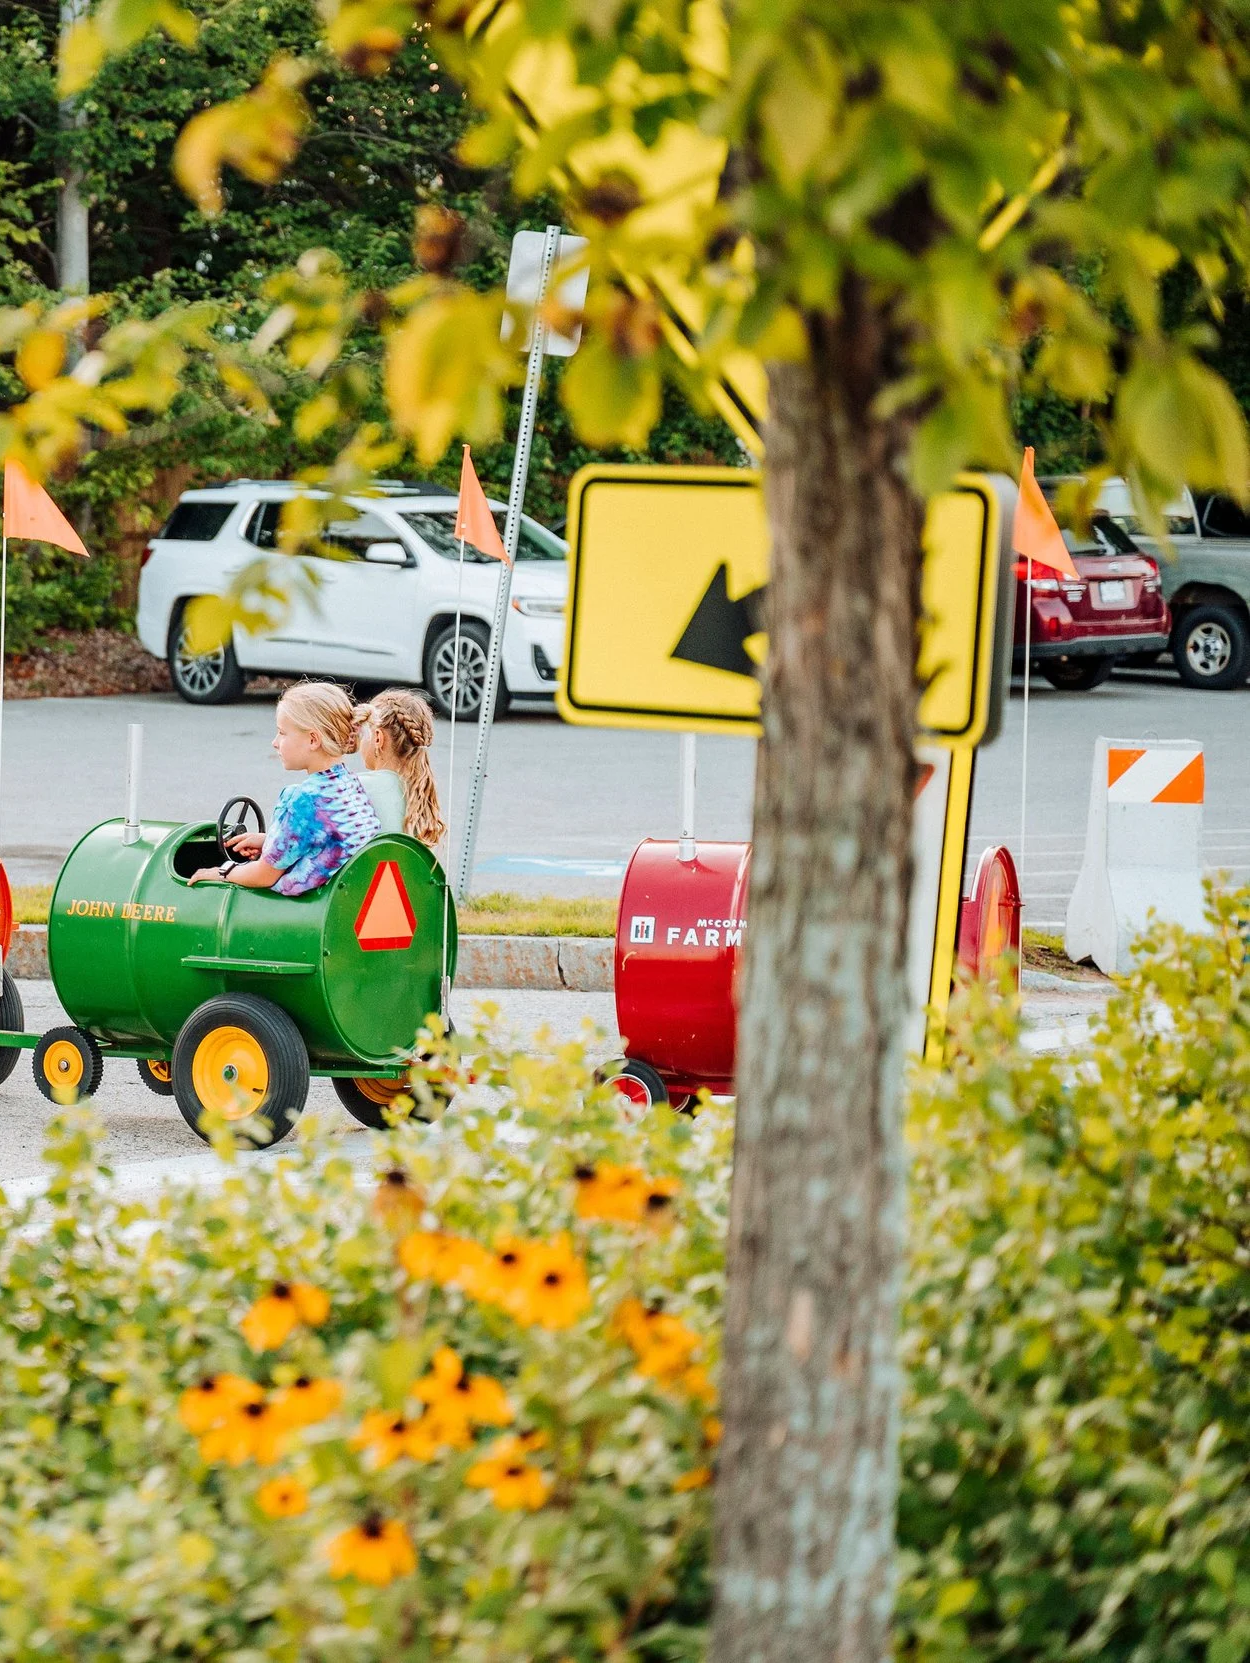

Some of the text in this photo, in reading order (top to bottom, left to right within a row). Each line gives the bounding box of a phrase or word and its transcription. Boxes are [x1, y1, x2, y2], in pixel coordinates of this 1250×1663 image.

[66, 899, 177, 923] JOHN DEERE
[696, 918, 748, 929] McCORM
[666, 927, 743, 947] FARM
